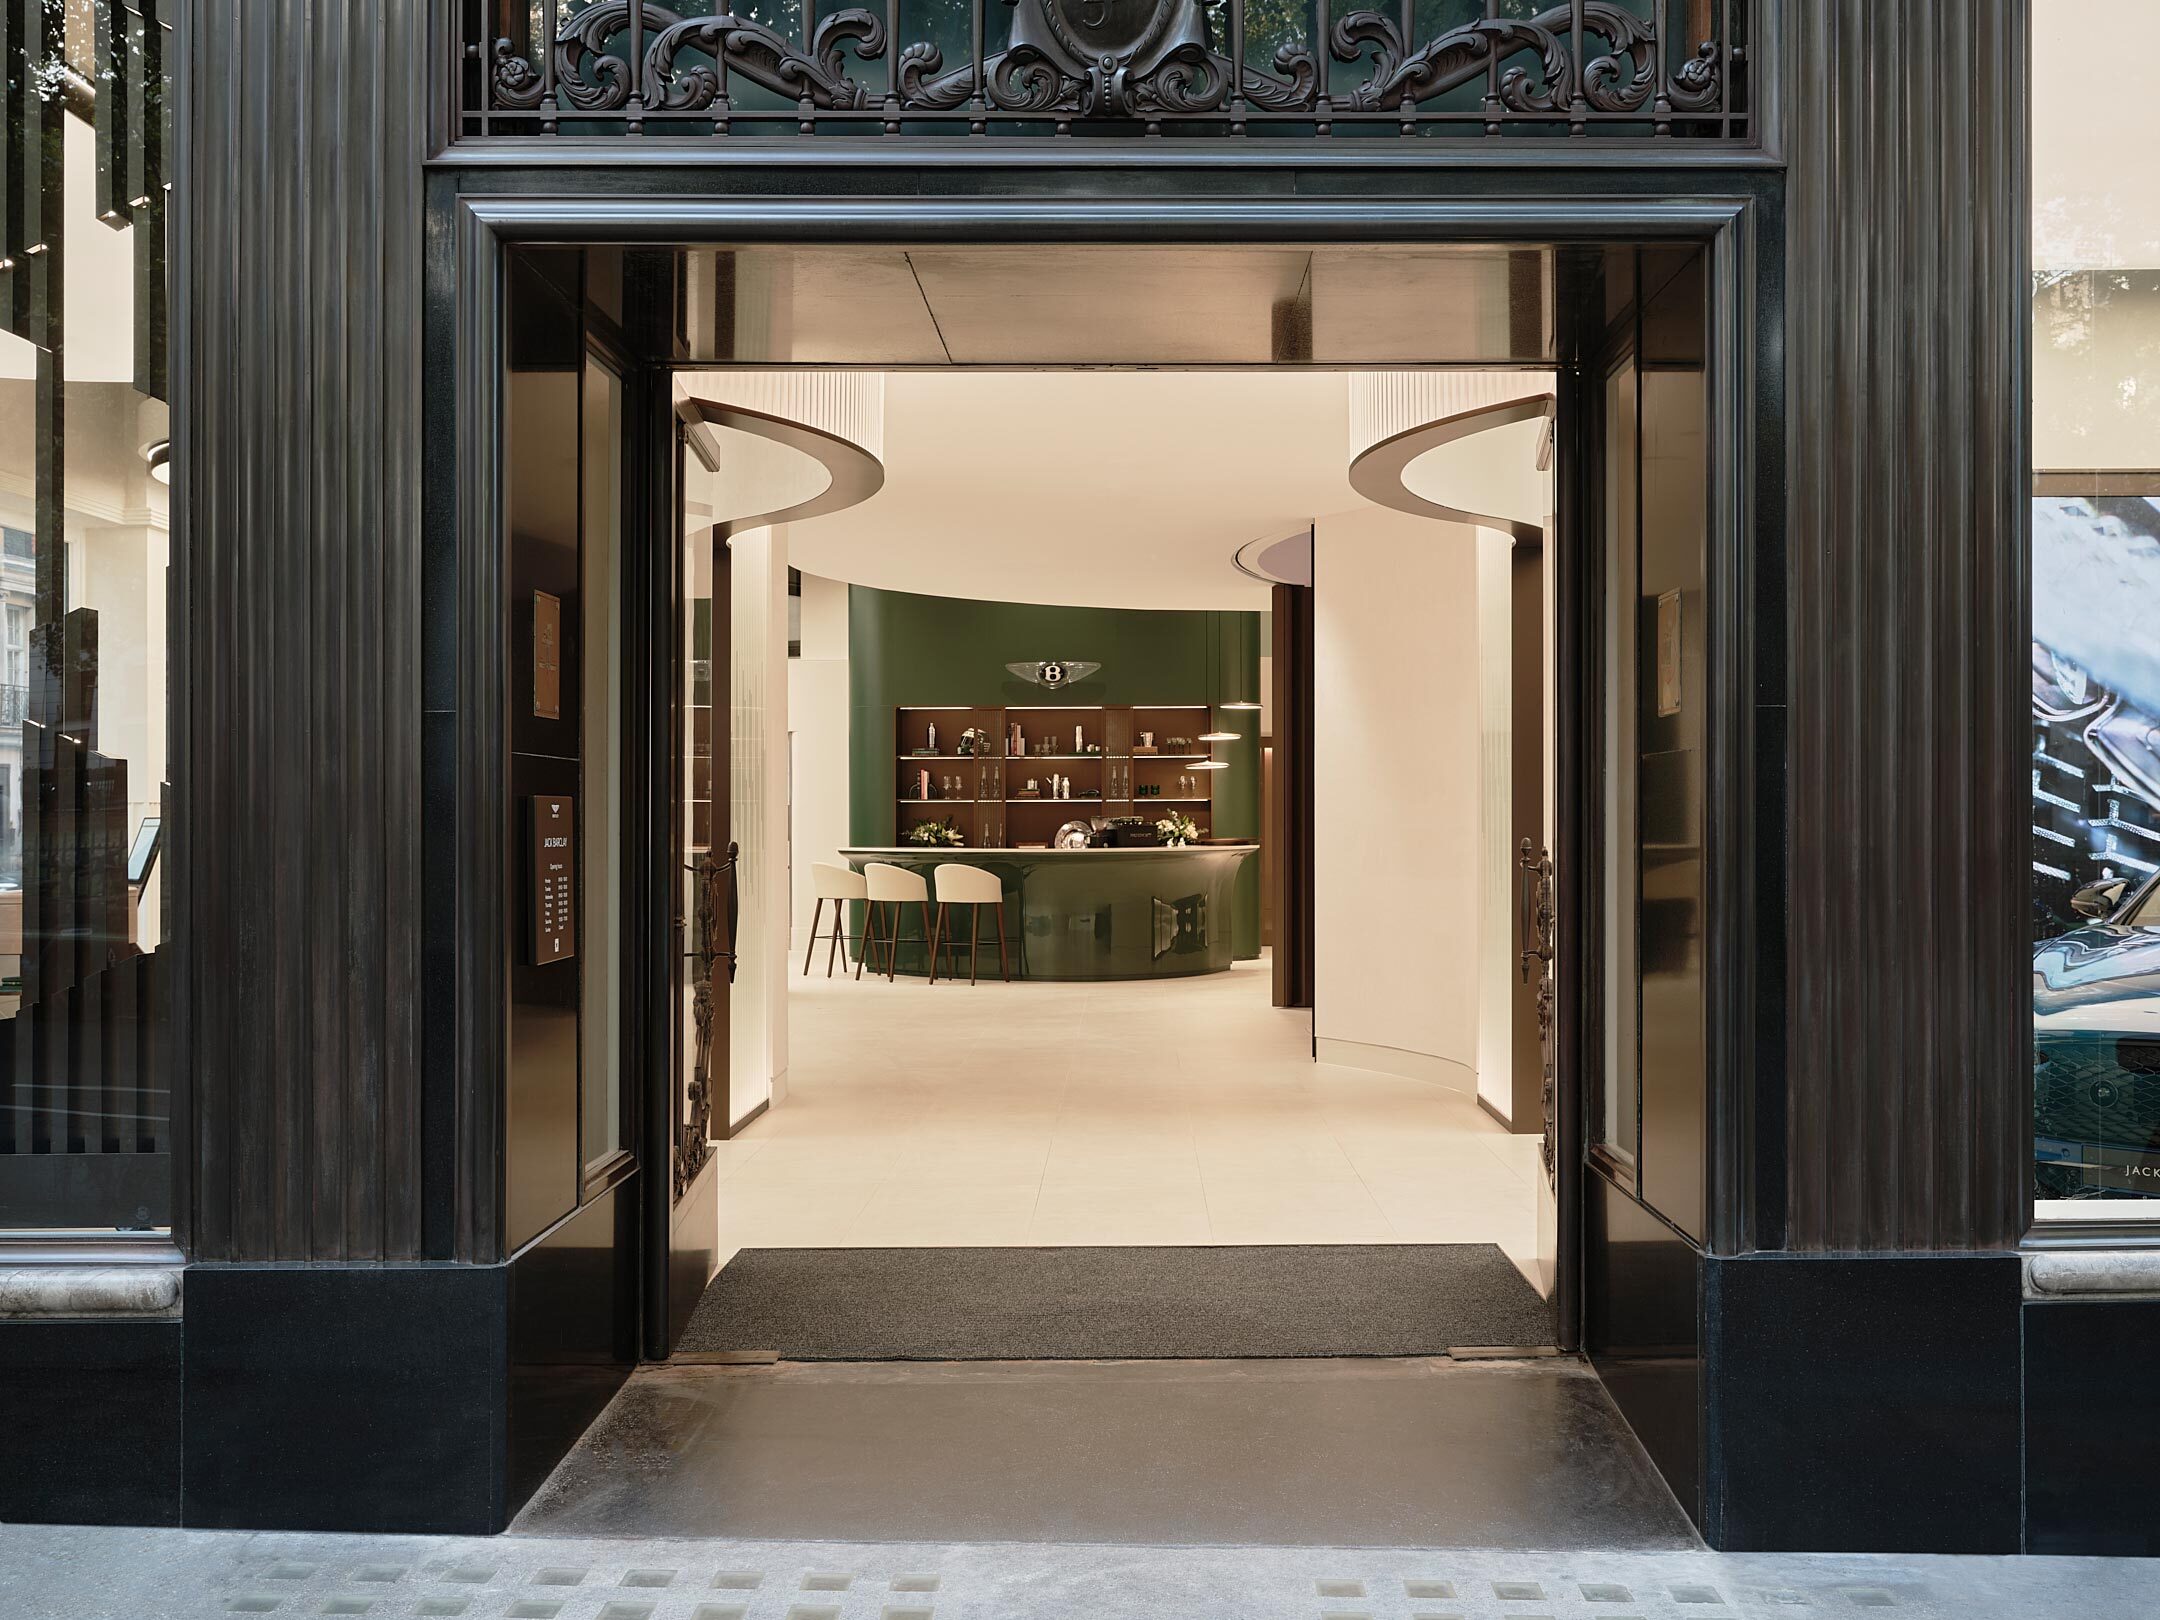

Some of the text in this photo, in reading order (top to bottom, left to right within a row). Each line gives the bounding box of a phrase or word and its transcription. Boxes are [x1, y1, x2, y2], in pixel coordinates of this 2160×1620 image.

[544, 837, 568, 848] JACK BARCLAY
[2125, 1164, 2160, 1178] JACK
